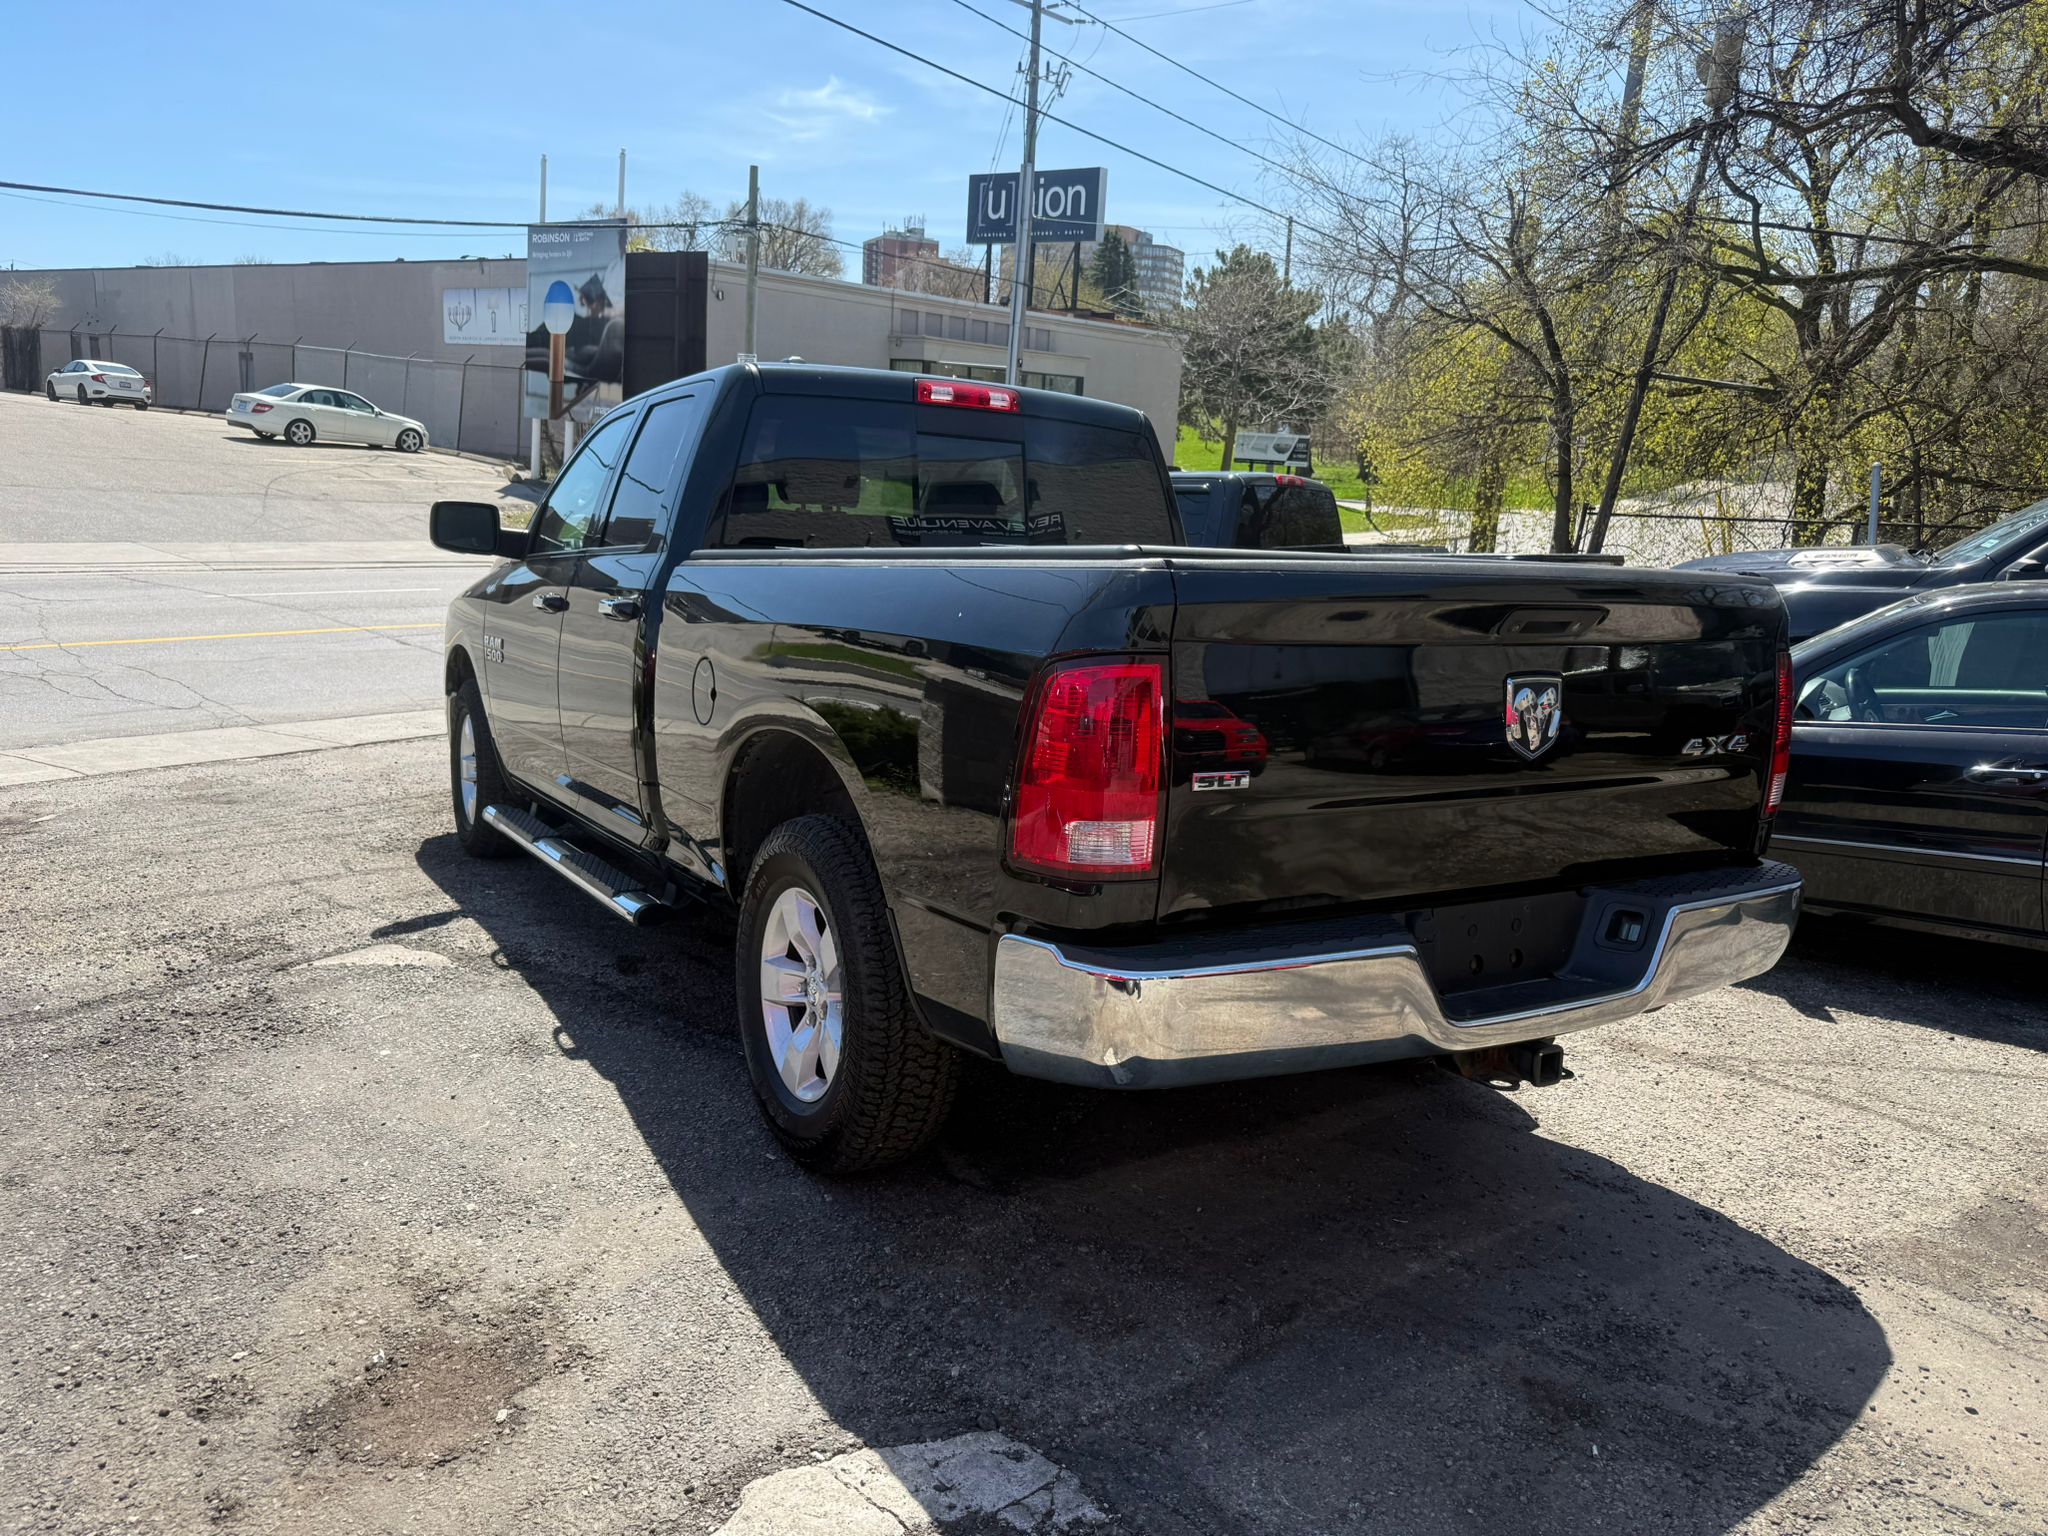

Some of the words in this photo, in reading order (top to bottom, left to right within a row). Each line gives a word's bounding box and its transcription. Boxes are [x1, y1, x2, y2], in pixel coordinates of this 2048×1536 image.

[532, 232, 571, 243] ROBINSON
[484, 635, 503, 649] RAM
[484, 647, 504, 663] 1500
[1197, 774, 1248, 788] SLT
